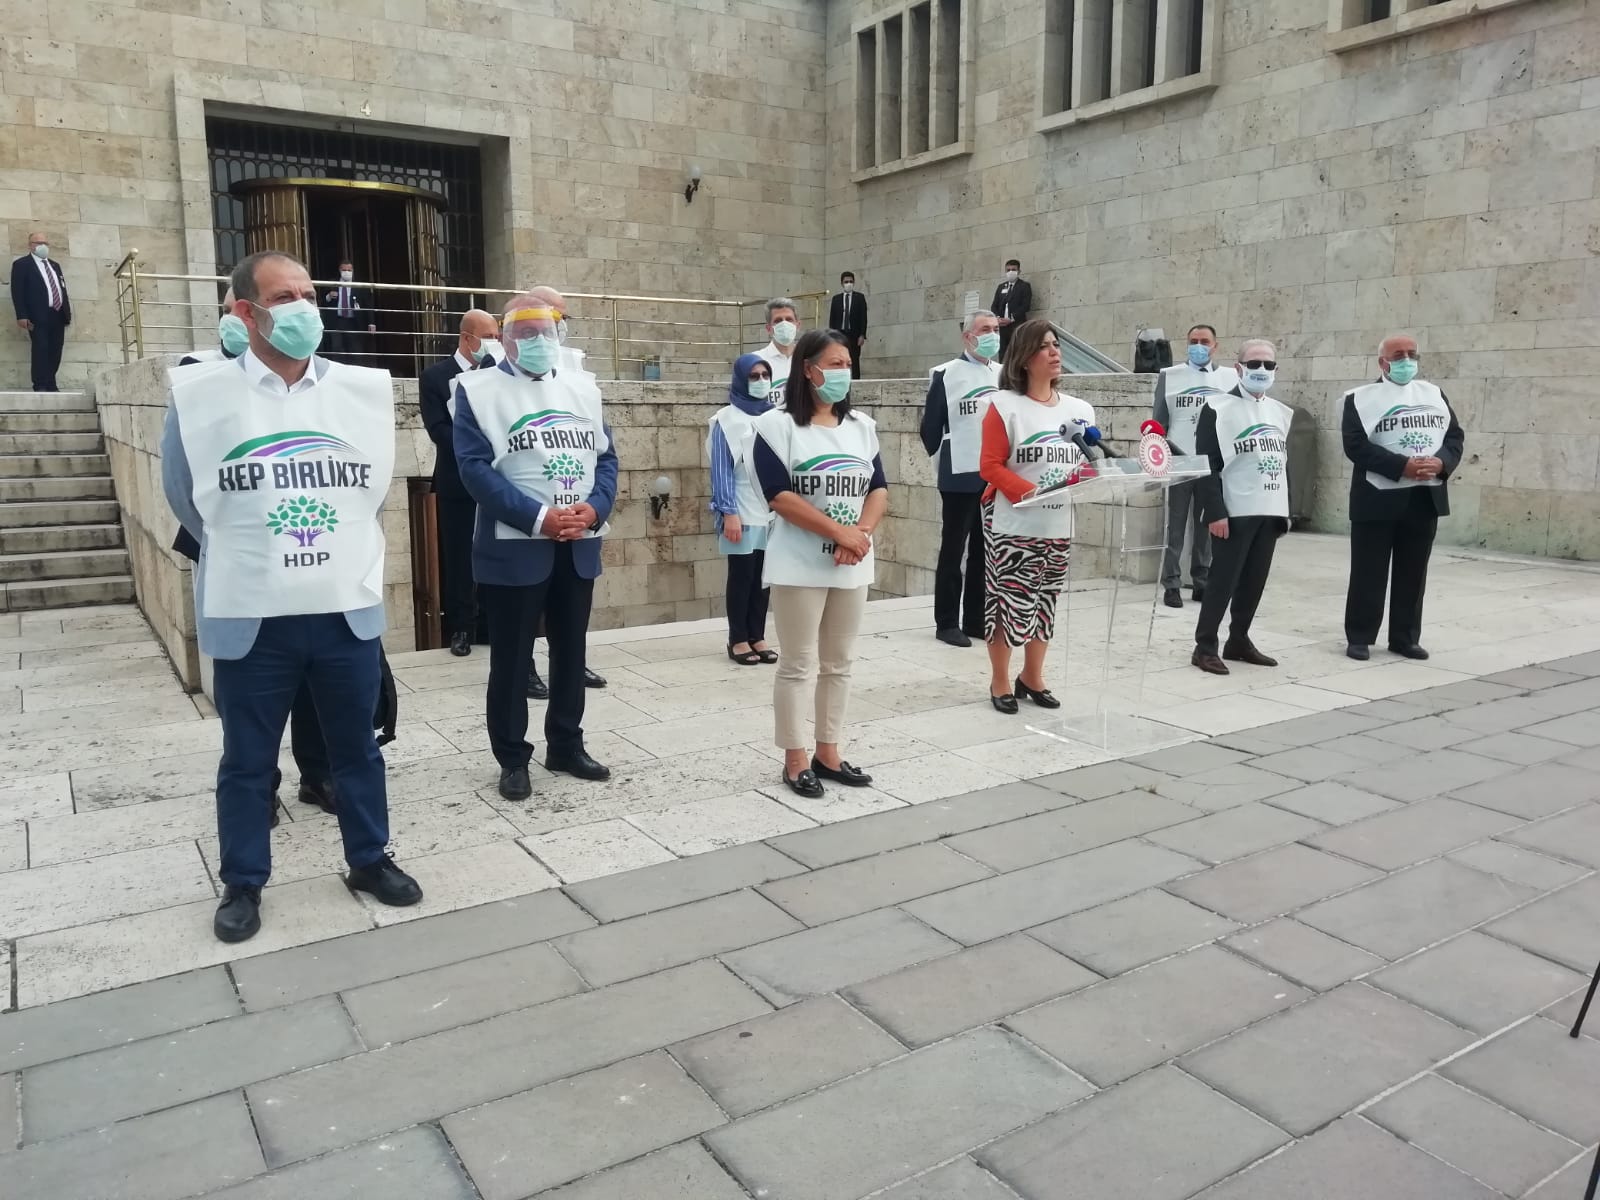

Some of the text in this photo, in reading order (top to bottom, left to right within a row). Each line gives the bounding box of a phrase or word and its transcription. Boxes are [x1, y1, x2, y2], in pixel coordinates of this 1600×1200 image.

[360, 98, 372, 117] 4
[768, 391, 781, 404] EP
[1176, 396, 1194, 408] HEP
[1375, 418, 1398, 433] HEP
[508, 429, 538, 453] HEP
[1233, 439, 1257, 455] HEP
[1016, 446, 1043, 464] HEP
[218, 455, 372, 492] HEP BİRLİKTE
[791, 474, 821, 496] HEP
[553, 494, 580, 505] HDP
[284, 552, 331, 568] HDP
